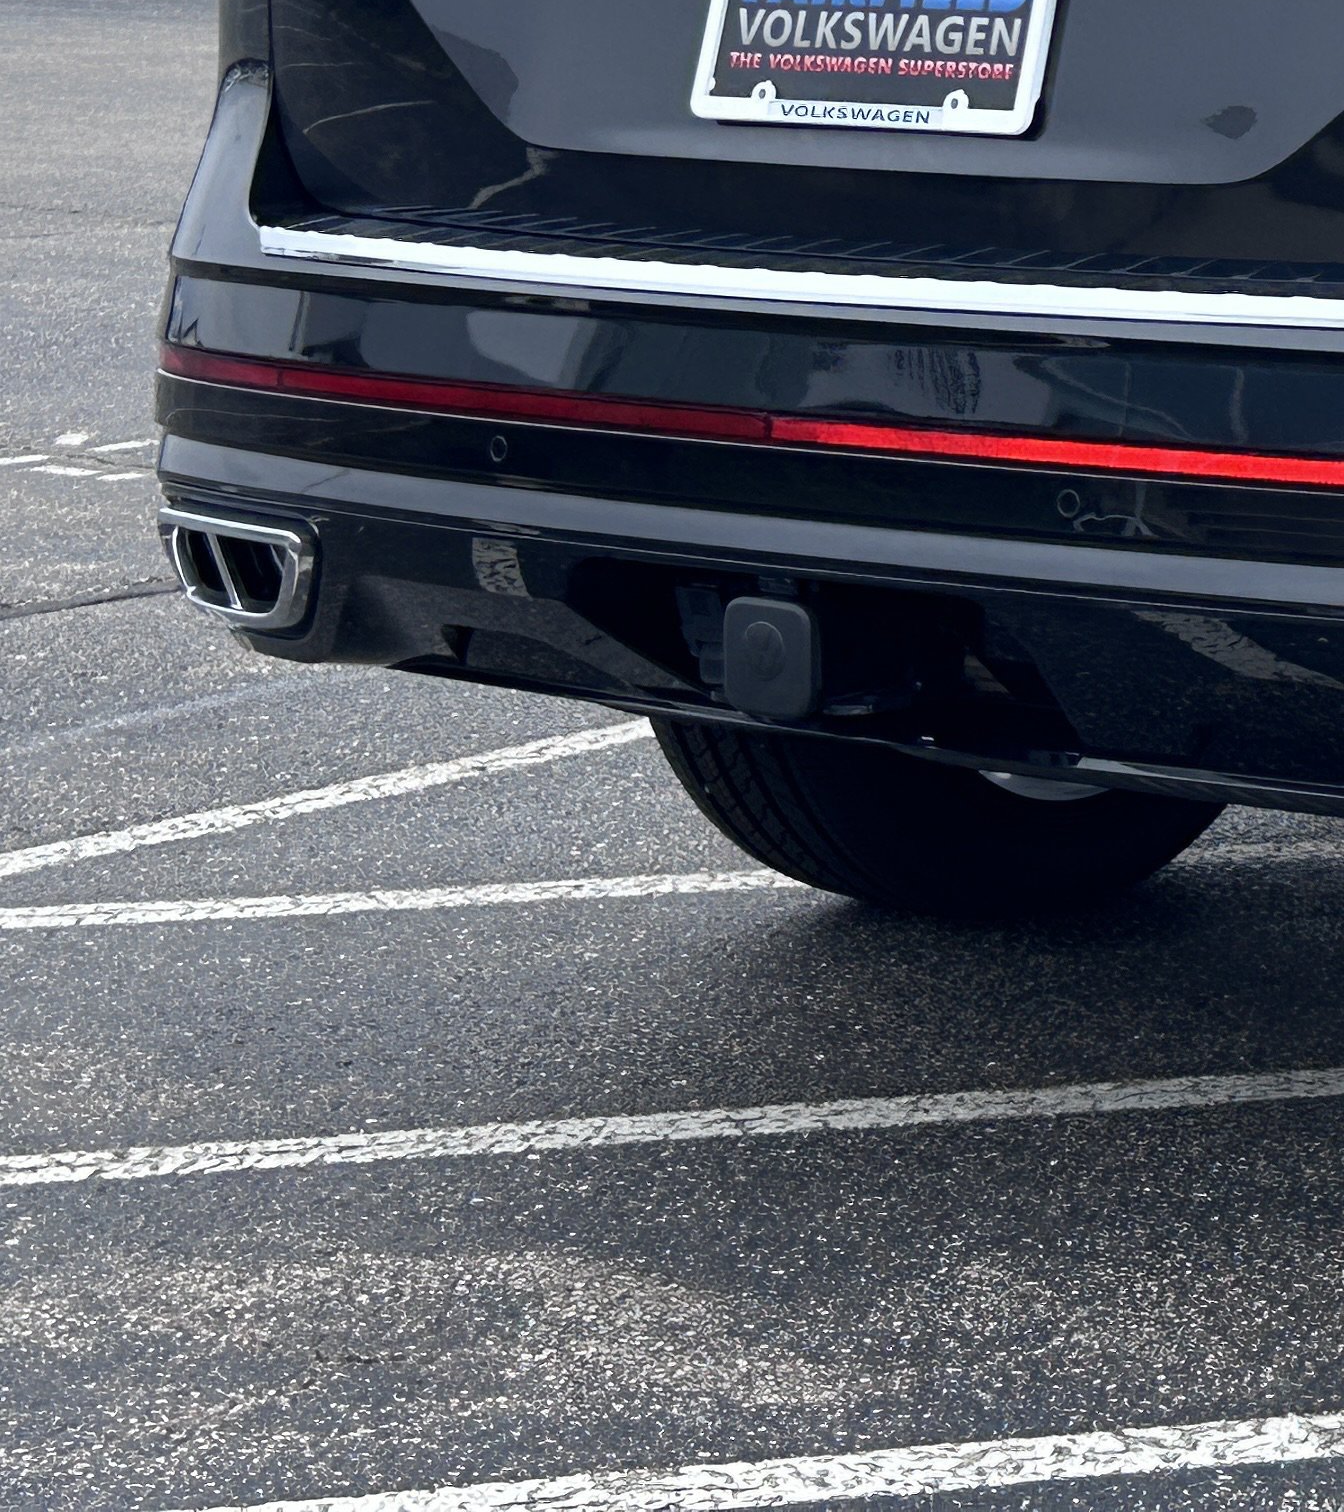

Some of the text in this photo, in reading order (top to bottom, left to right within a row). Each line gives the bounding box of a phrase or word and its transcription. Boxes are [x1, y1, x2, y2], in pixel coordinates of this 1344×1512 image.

[738, 8, 1022, 57] VOLKSWAGEN
[730, 51, 1014, 81] THE VOLKSWAGEN SUPERSTORE
[781, 103, 930, 125] VOLKSWAGEN
